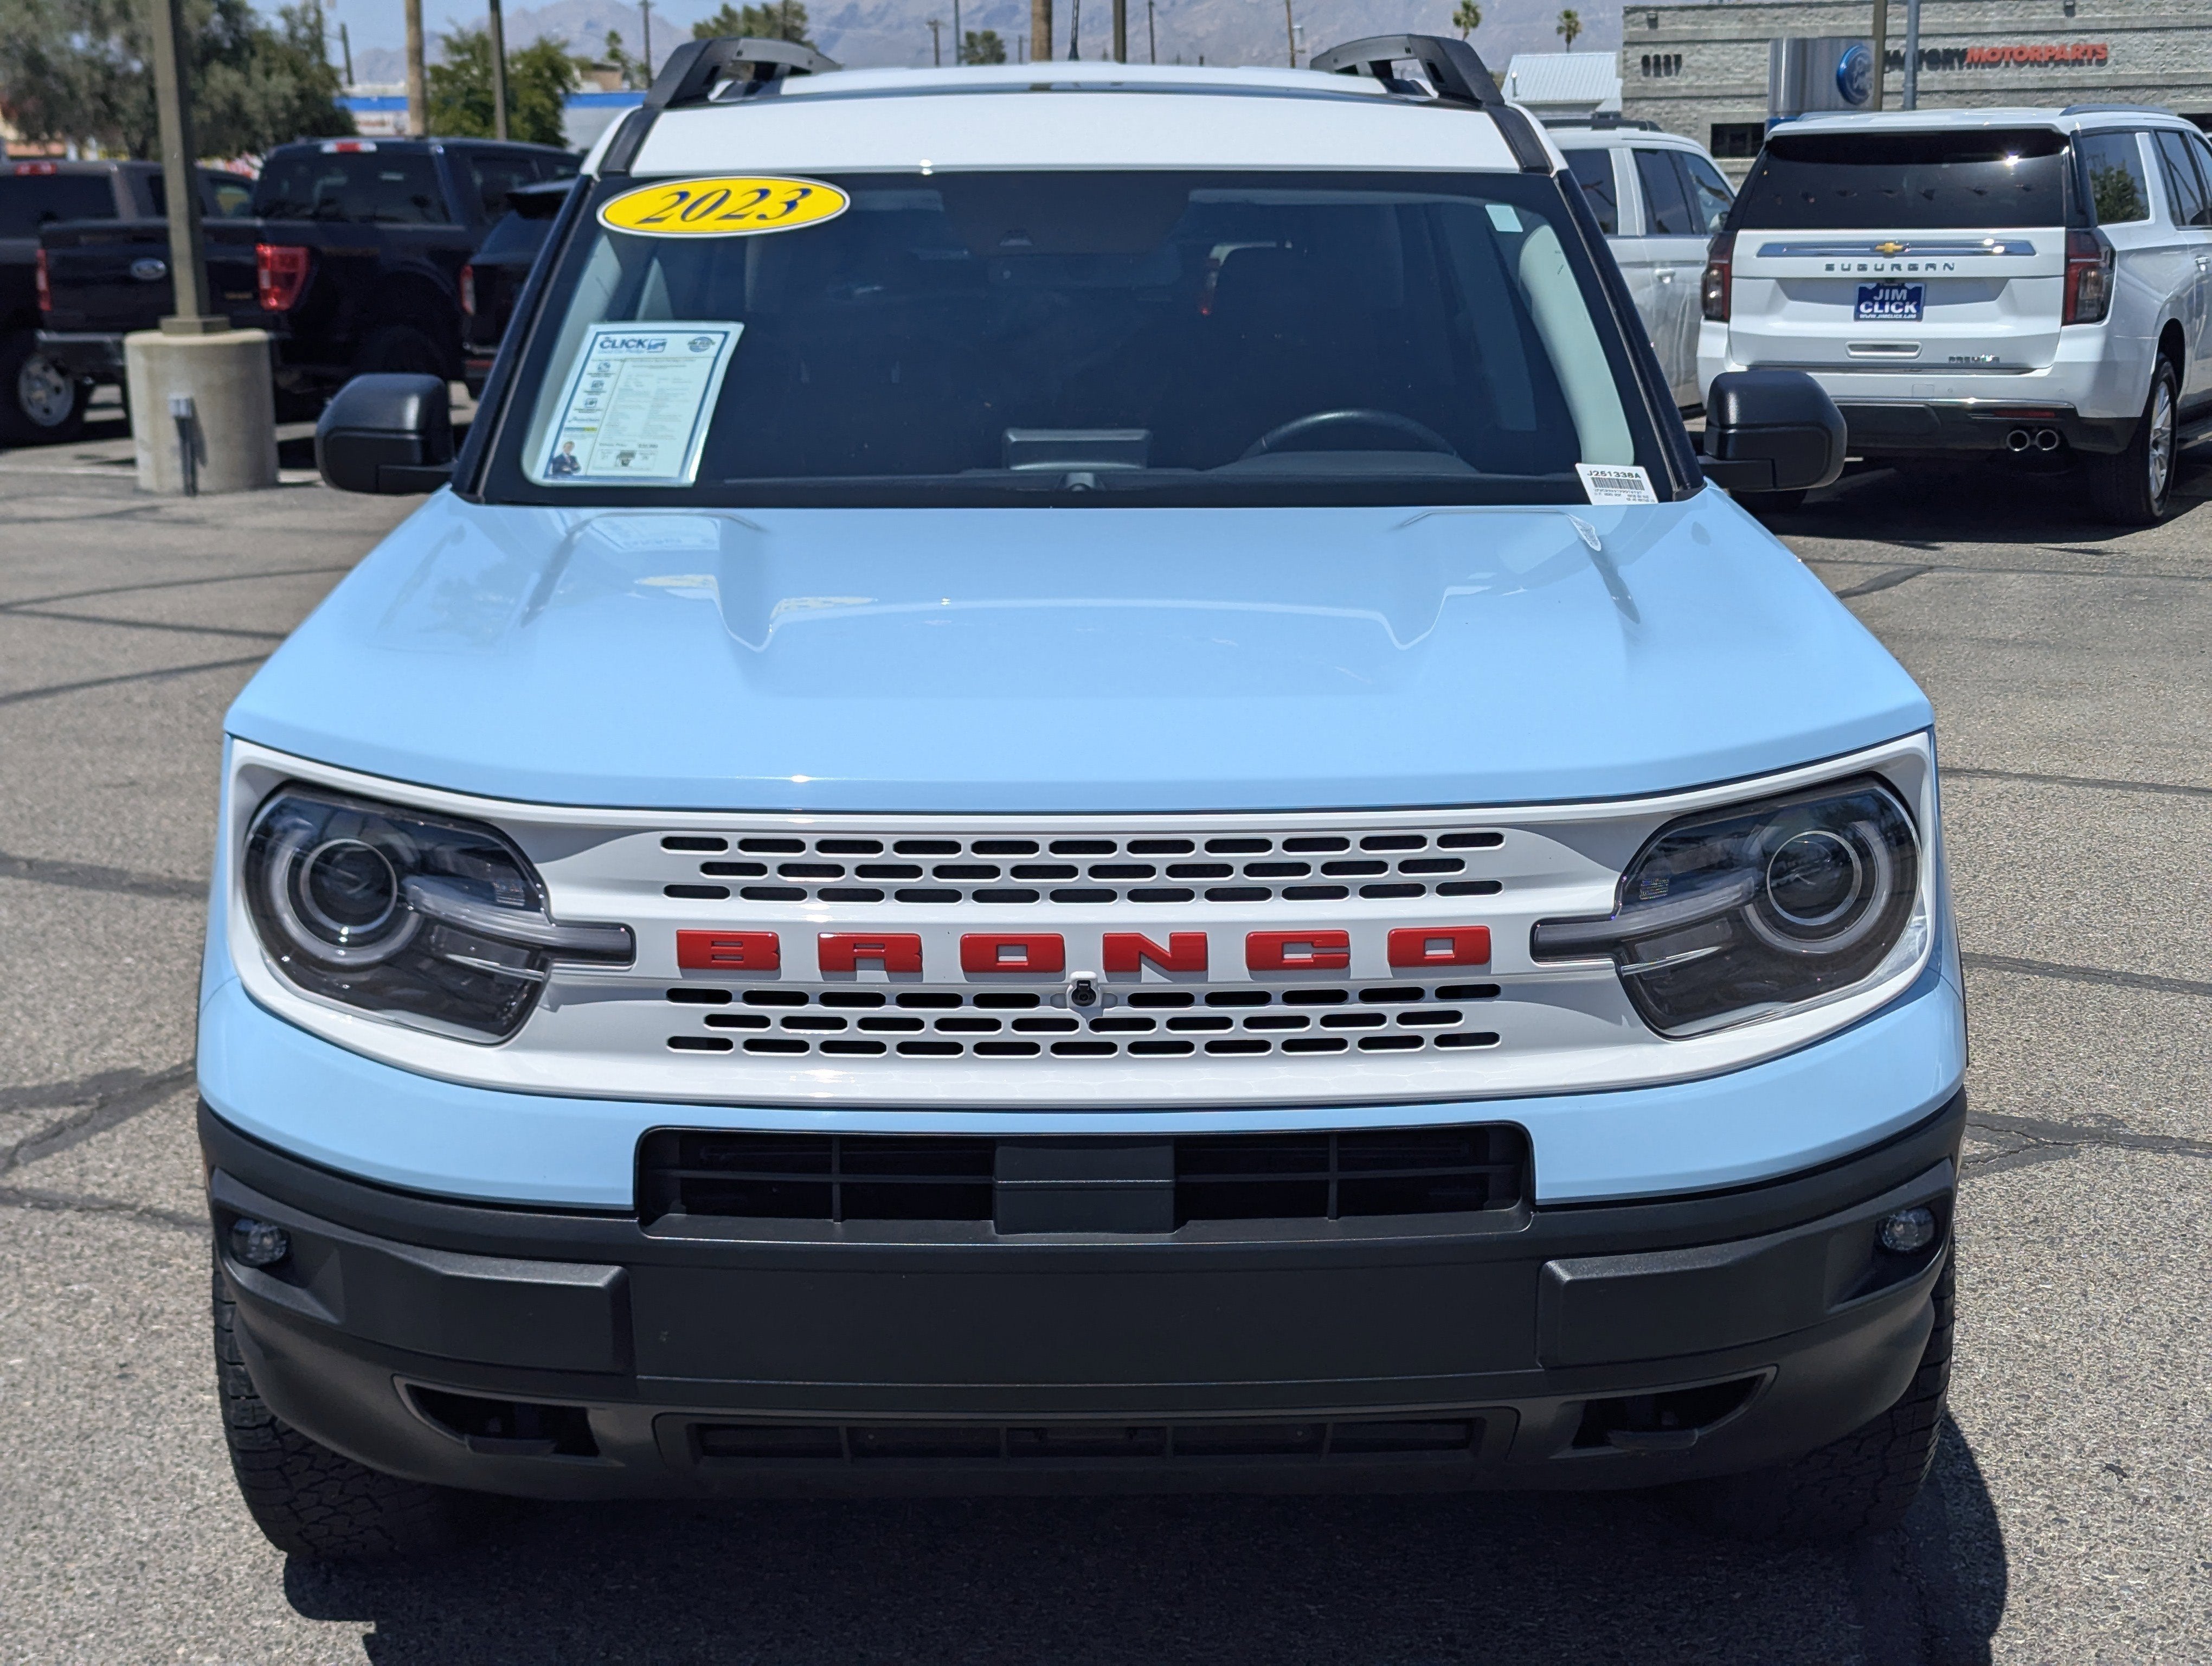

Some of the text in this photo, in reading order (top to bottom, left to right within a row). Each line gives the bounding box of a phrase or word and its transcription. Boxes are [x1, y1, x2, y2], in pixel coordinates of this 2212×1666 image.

[1882, 43, 2107, 68] ATORY MOTORPARTS
[634, 188, 813, 225] 2023
[1825, 262, 1955, 271] SUBURBAN
[1873, 289, 1907, 300] JIM
[1860, 301, 1918, 313] CLICK
[600, 338, 648, 349] CLICK
[676, 925, 1490, 973] BRONCO
